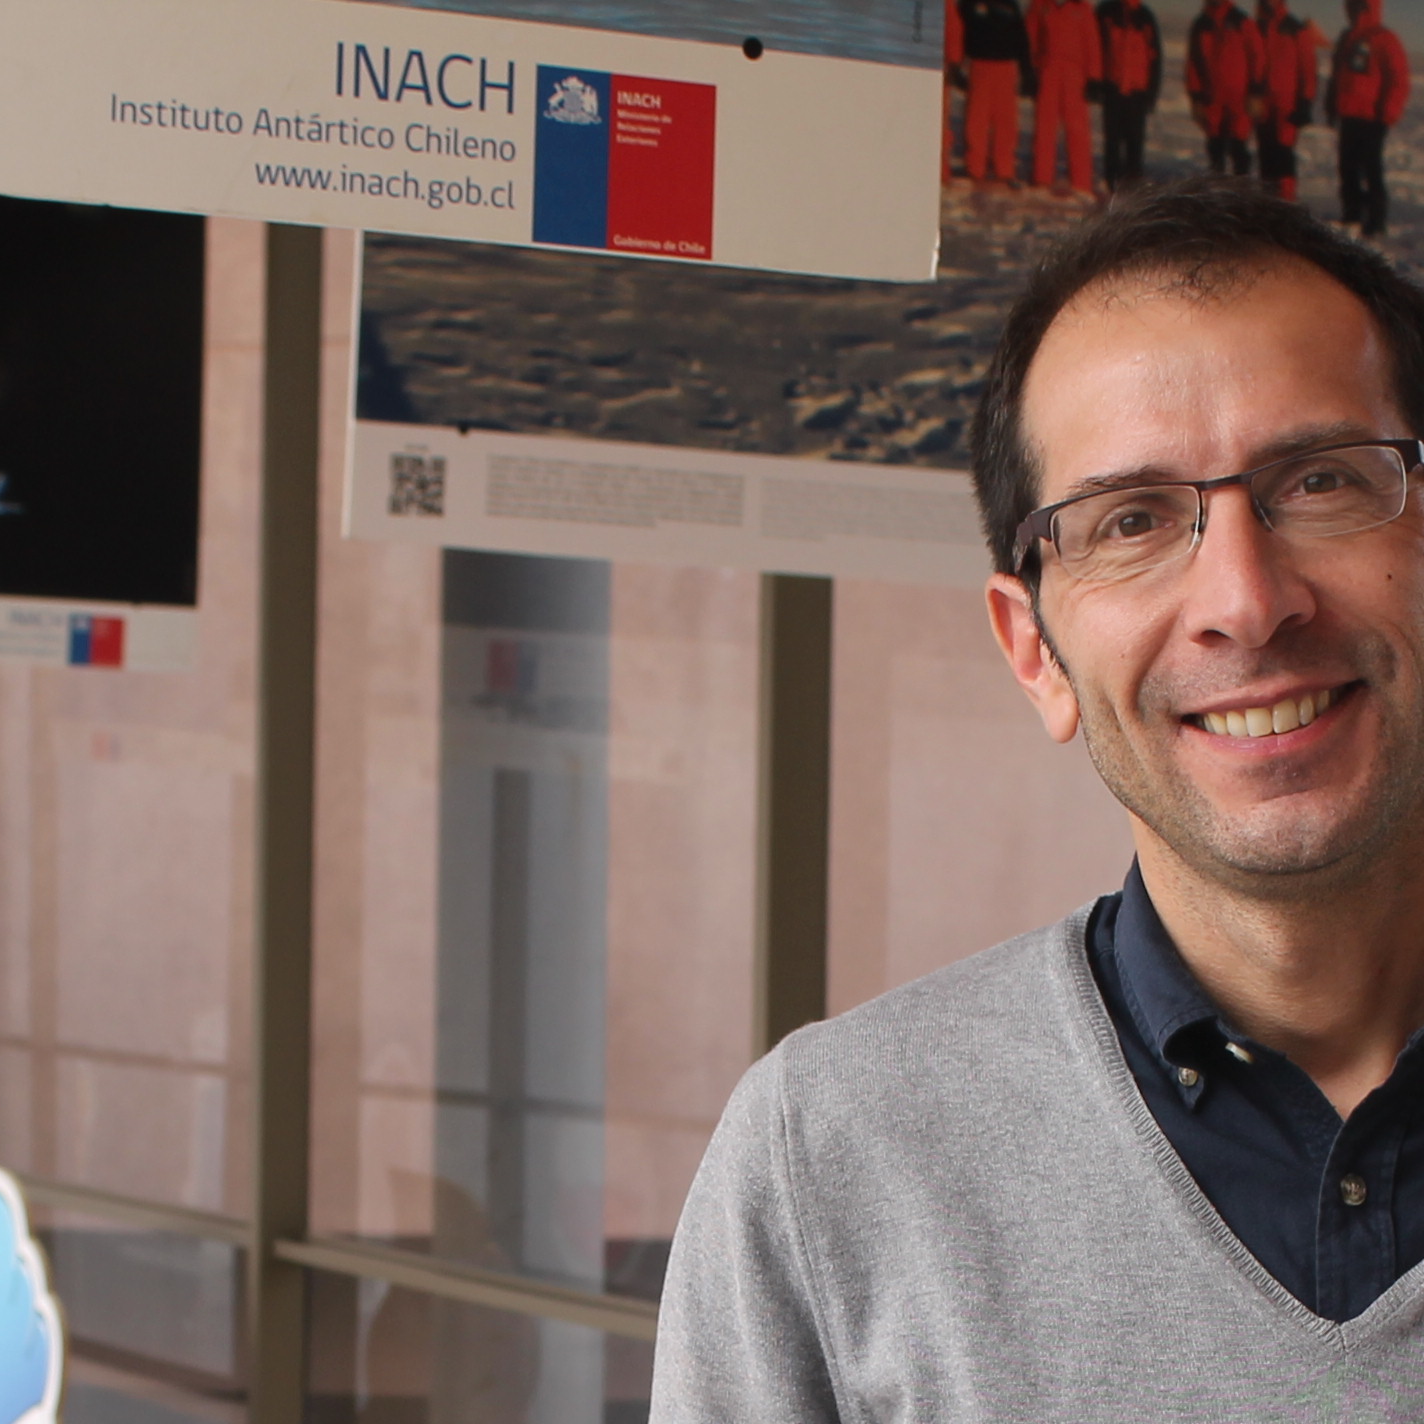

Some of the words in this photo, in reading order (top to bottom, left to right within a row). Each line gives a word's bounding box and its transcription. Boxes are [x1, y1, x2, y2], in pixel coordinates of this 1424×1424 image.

[335, 40, 516, 115] INACH
[617, 90, 661, 109] INACH
[109, 93, 244, 136] Instituto
[252, 107, 396, 151] Antártico
[404, 122, 517, 163] Chileno
[254, 161, 516, 210] www.inach.gob.cl
[678, 241, 706, 254] Chile
